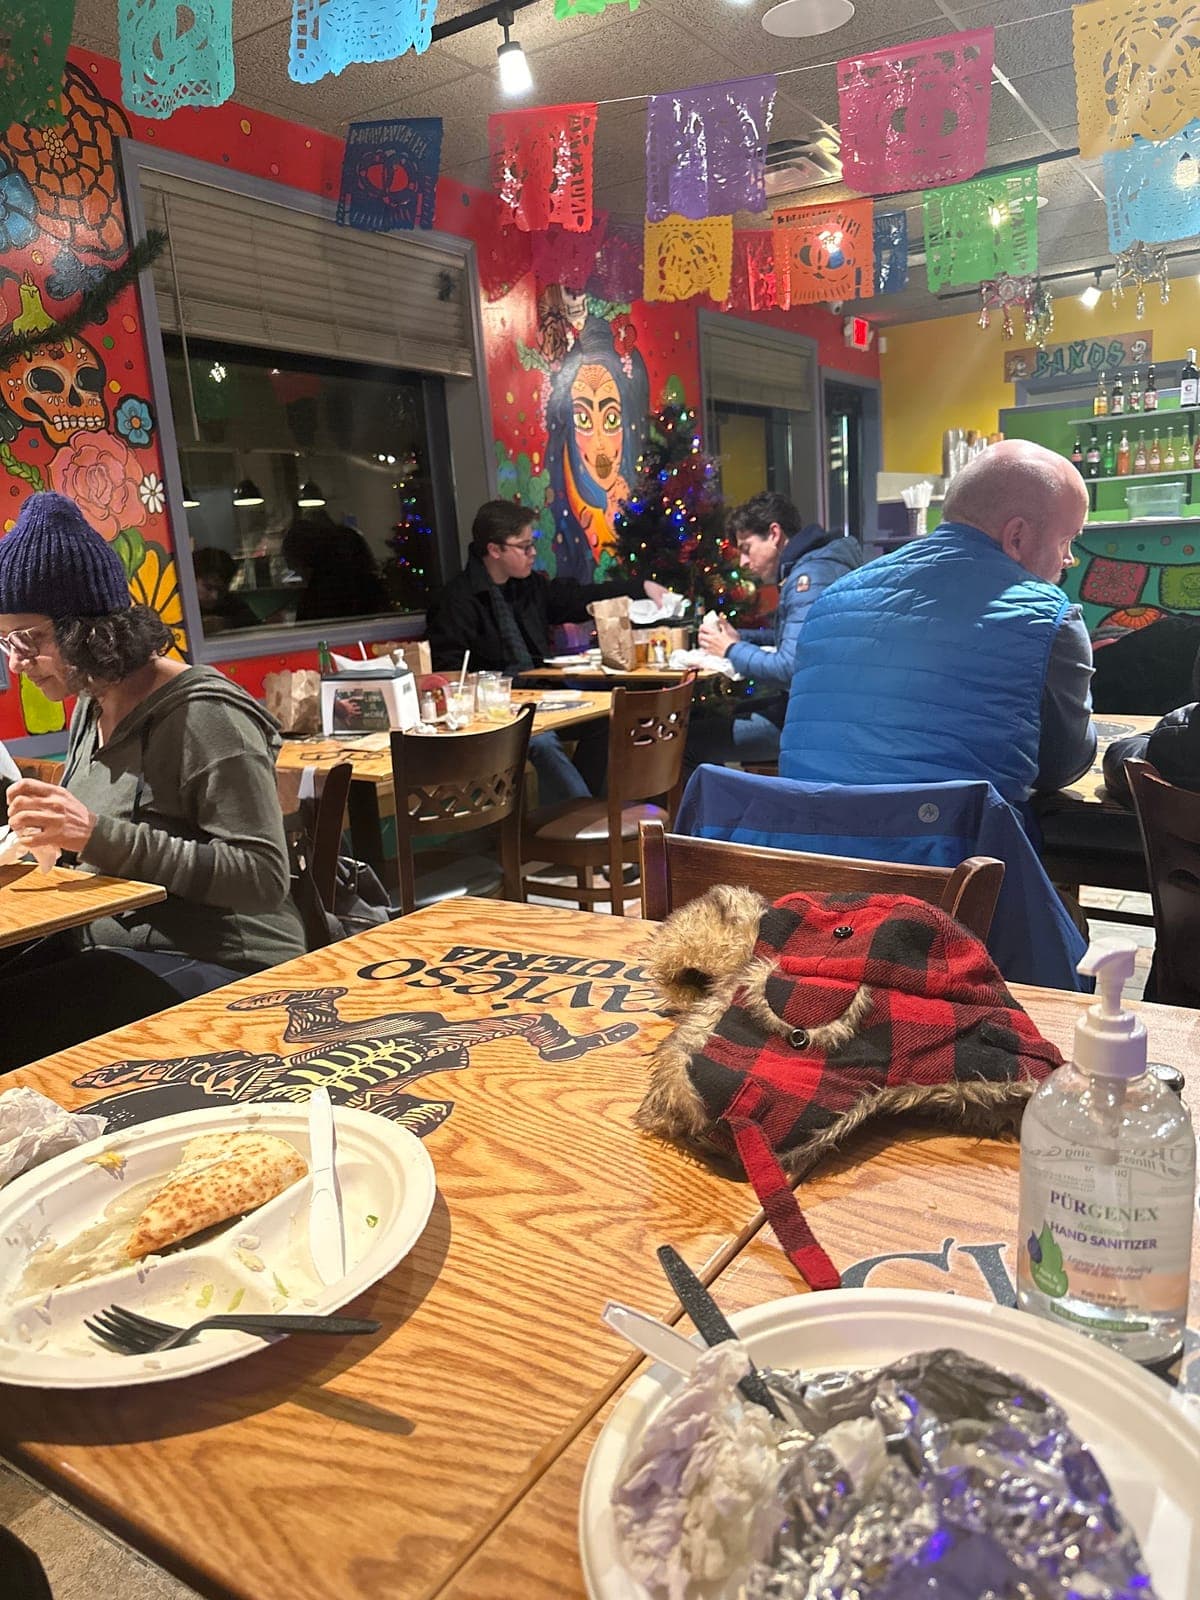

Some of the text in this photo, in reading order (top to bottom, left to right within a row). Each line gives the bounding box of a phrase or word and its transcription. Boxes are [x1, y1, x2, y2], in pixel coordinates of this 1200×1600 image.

[1031, 340, 1126, 378] BAÑOS
[1050, 1190, 1159, 1222] PÜRGENEX
[1050, 1221, 1087, 1243] HAND
[1090, 1235, 1157, 1250] SANITIZER
